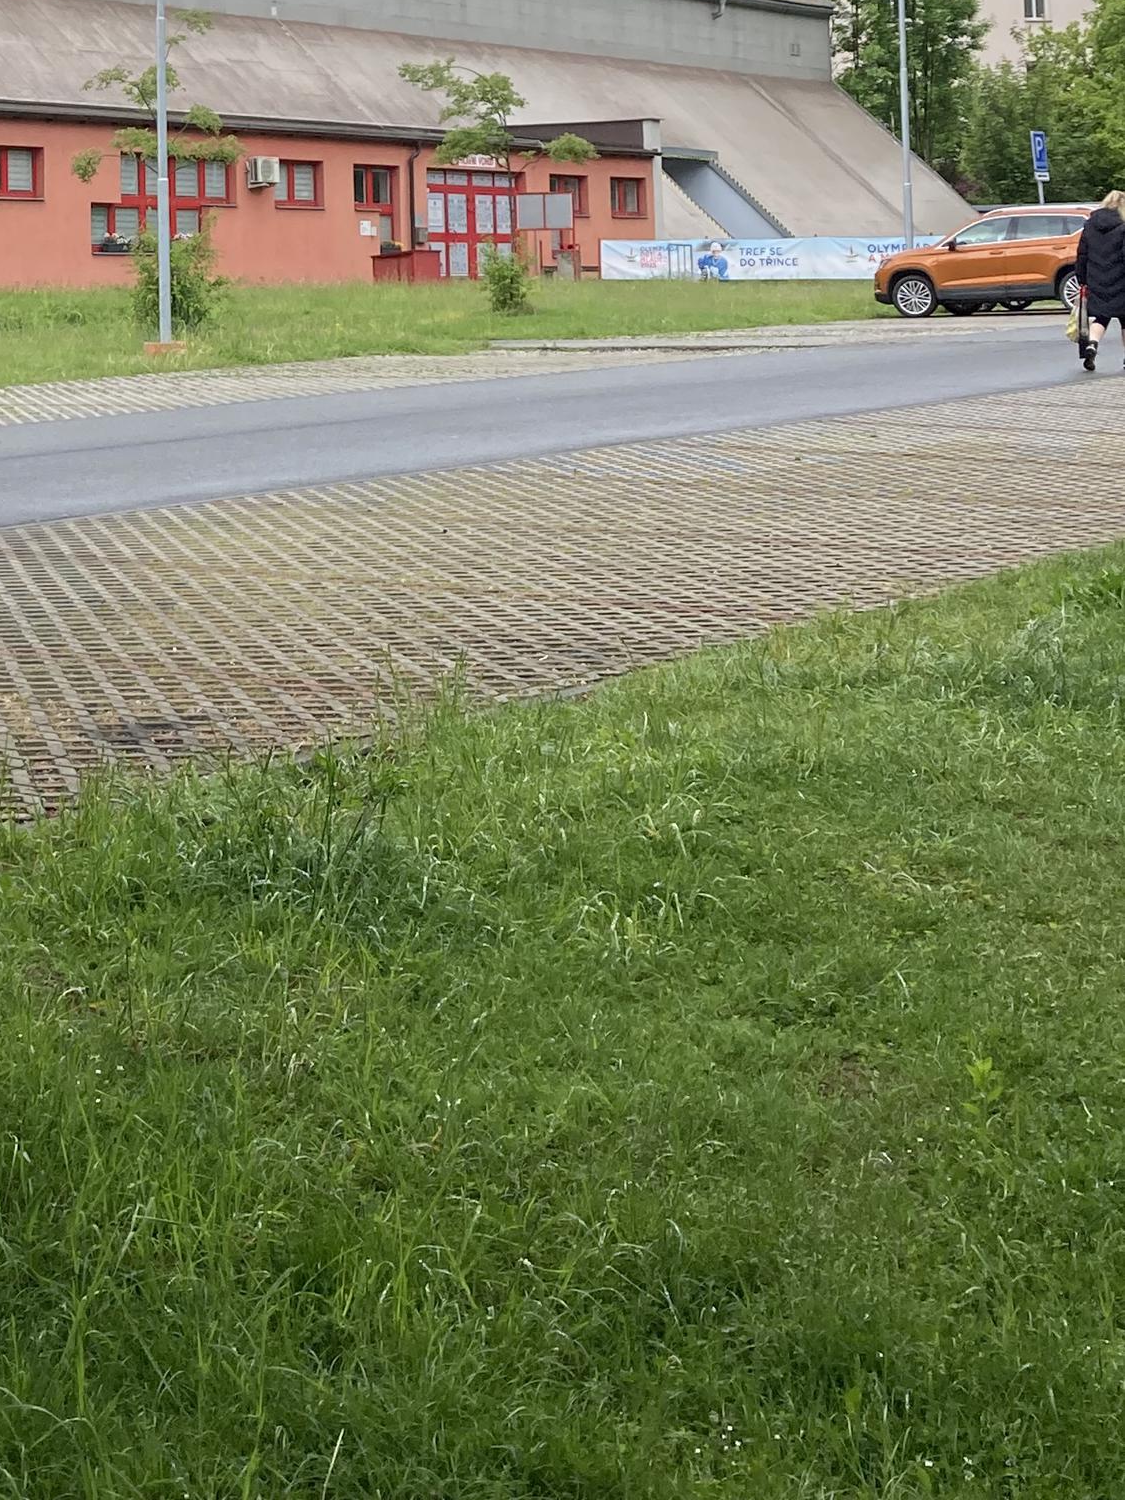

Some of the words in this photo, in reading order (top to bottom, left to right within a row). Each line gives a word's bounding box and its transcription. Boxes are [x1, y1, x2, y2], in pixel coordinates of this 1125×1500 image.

[1035, 136, 1044, 159] P
[739, 247, 766, 256] TREF
[769, 247, 783, 256] SE
[739, 258, 756, 267] DO
